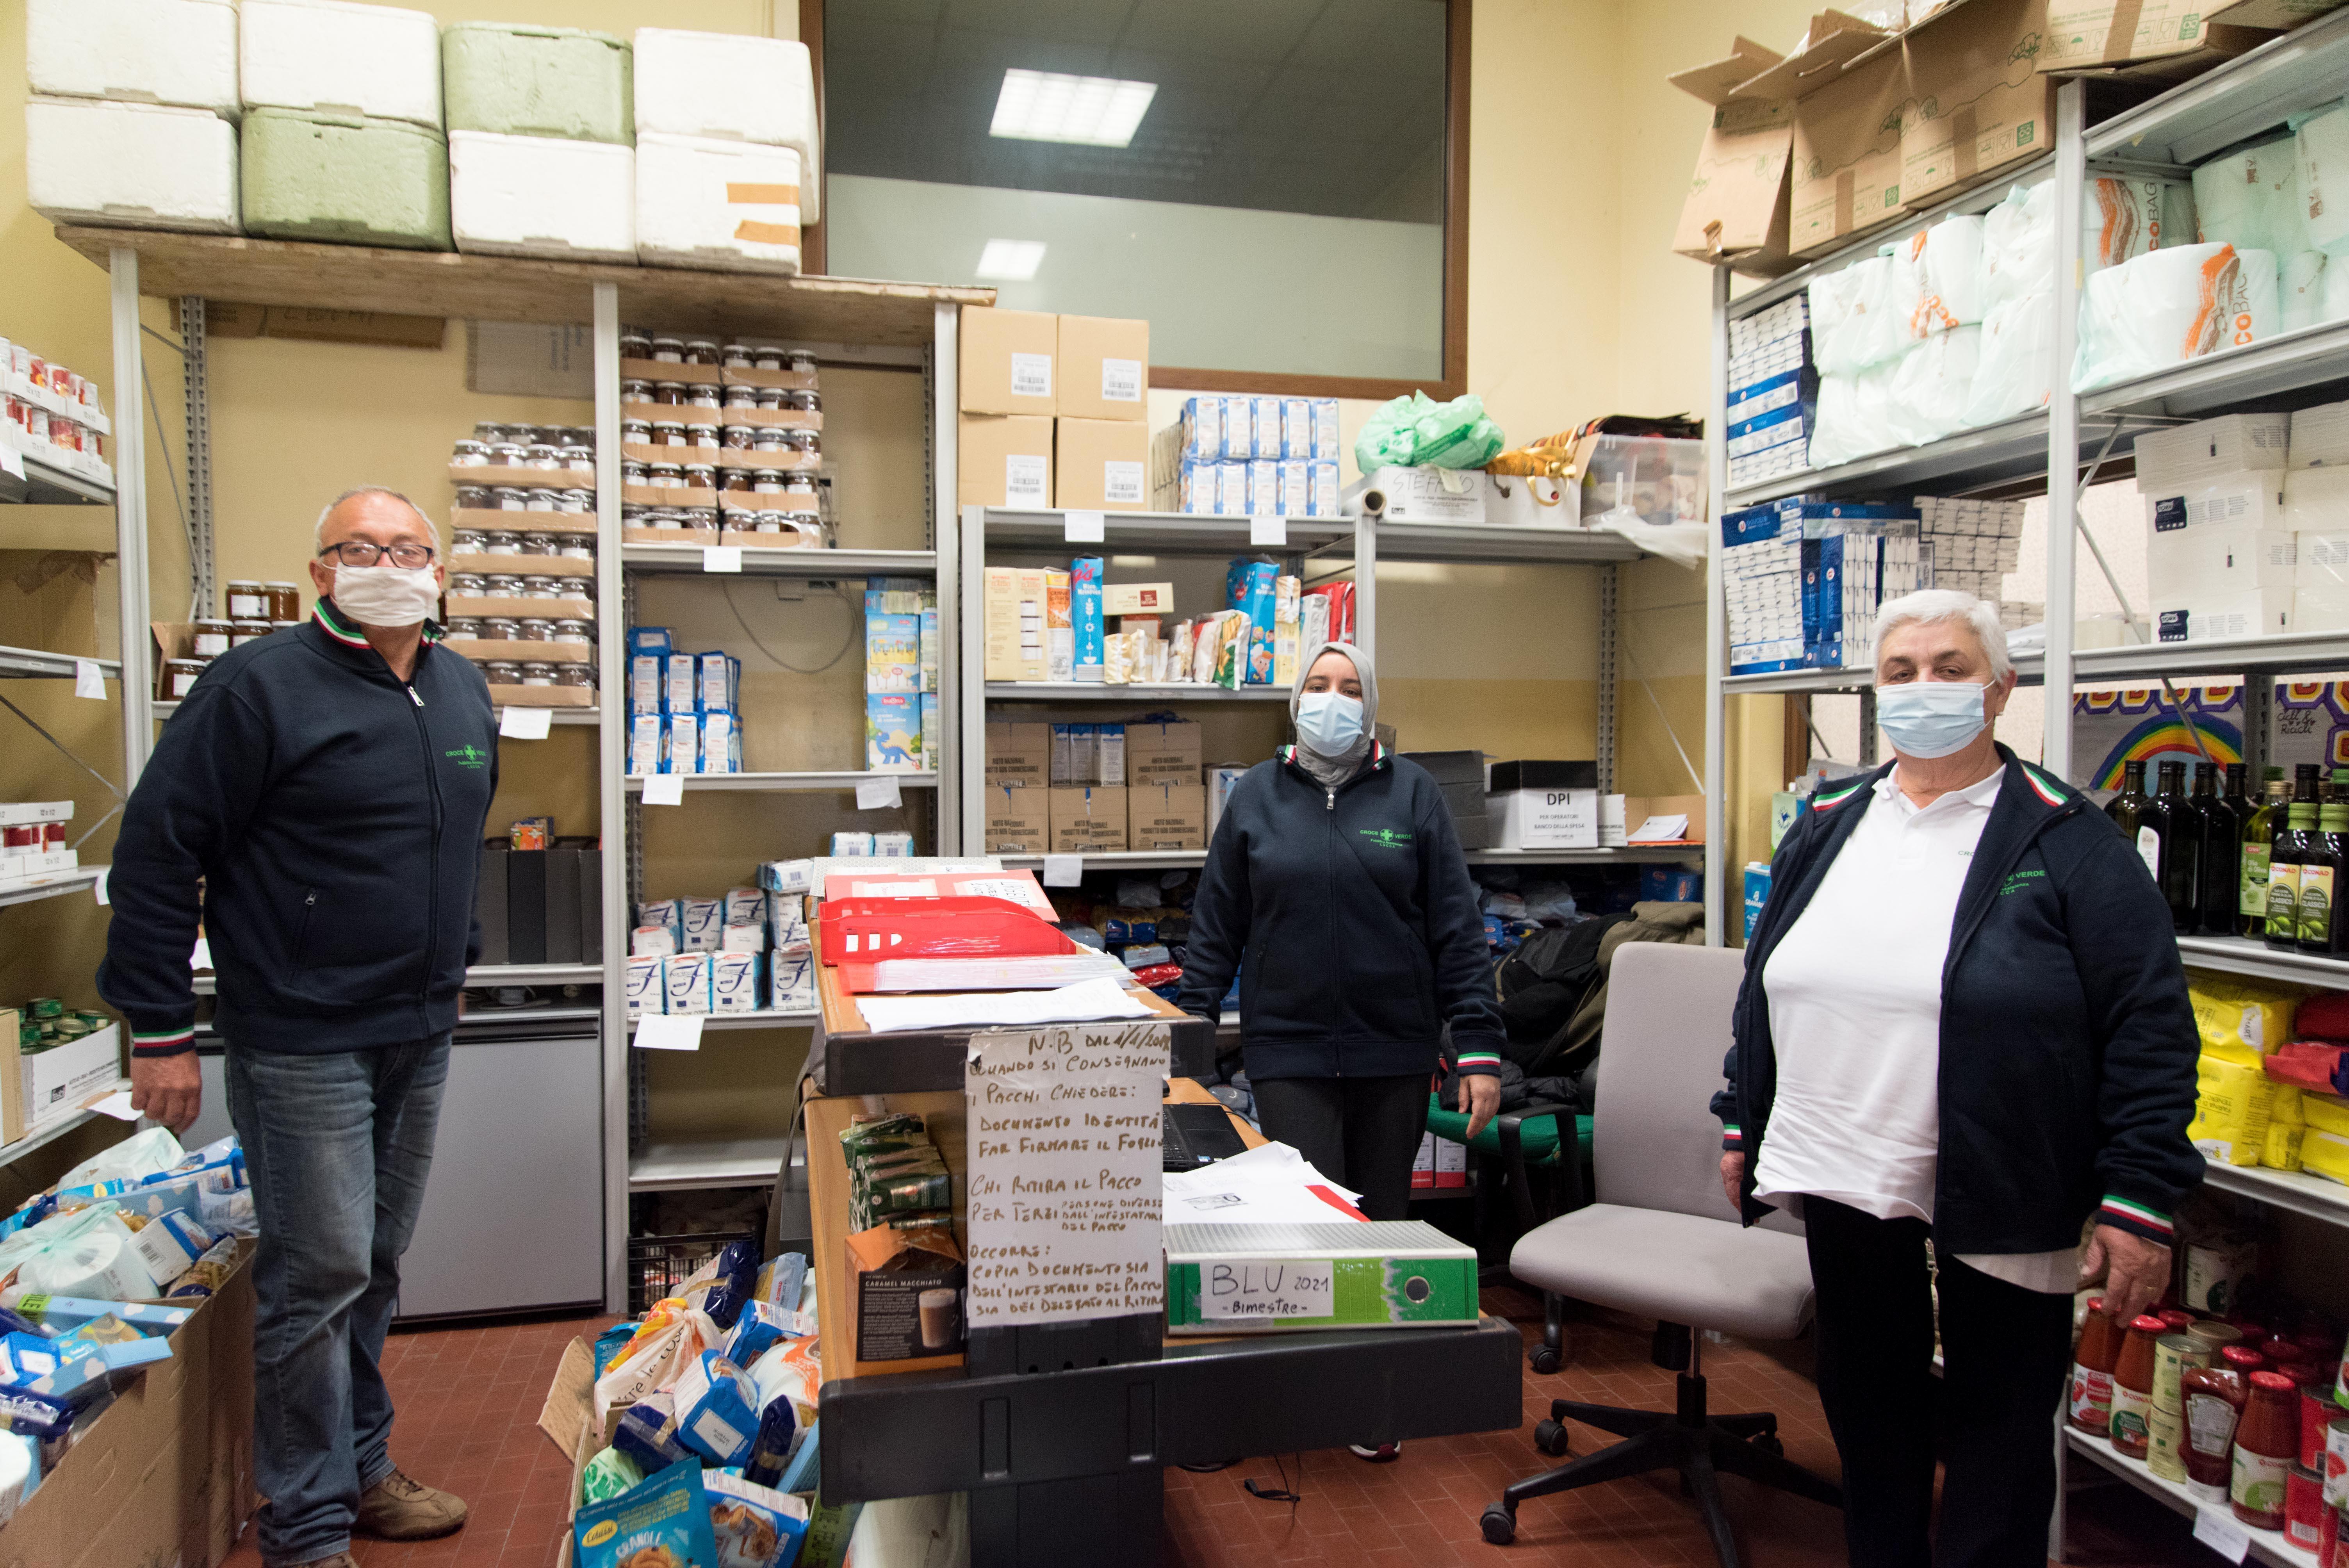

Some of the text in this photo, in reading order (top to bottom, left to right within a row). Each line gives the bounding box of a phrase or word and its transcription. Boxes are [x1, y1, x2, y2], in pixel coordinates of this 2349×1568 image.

[2145, 182, 2159, 251] COBAG
[1547, 793, 1570, 805] DPI
[2016, 870, 2046, 878] VERDE
[1085, 1034, 1110, 1048] DAL
[1042, 1060, 1055, 1071] SI
[1066, 1055, 1166, 1072] CONSEGNANO
[987, 1083, 1039, 1104] PACCHI
[980, 1116, 1070, 1131] DOCUMENTO
[979, 1141, 1011, 1158] FAR
[1020, 1137, 1089, 1153] FIRMARE
[1097, 1140, 1110, 1151] IL
[971, 1169, 1142, 1196] CHI RITIRA IL PACCO
[973, 1202, 1058, 1222] PER TERZI
[1062, 1198, 1163, 1210] PERSONE DIVERSE
[1062, 1222, 1126, 1232] DEL PACCO
[973, 1261, 1149, 1279] COPIA DOCUMENTO SIA
[900, 1279, 942, 1287] MACCHIATO
[1096, 1282, 1121, 1293] DEL
[1125, 1276, 1162, 1292] PACCO
[1212, 1264, 1328, 1296] BLU 2021
[976, 1305, 998, 1316] SIA
[1010, 1302, 1035, 1313] DEL
[1041, 1296, 1102, 1313] DELEGATO
[1106, 1297, 1120, 1307] AL
[641, 1364, 657, 1378] le
